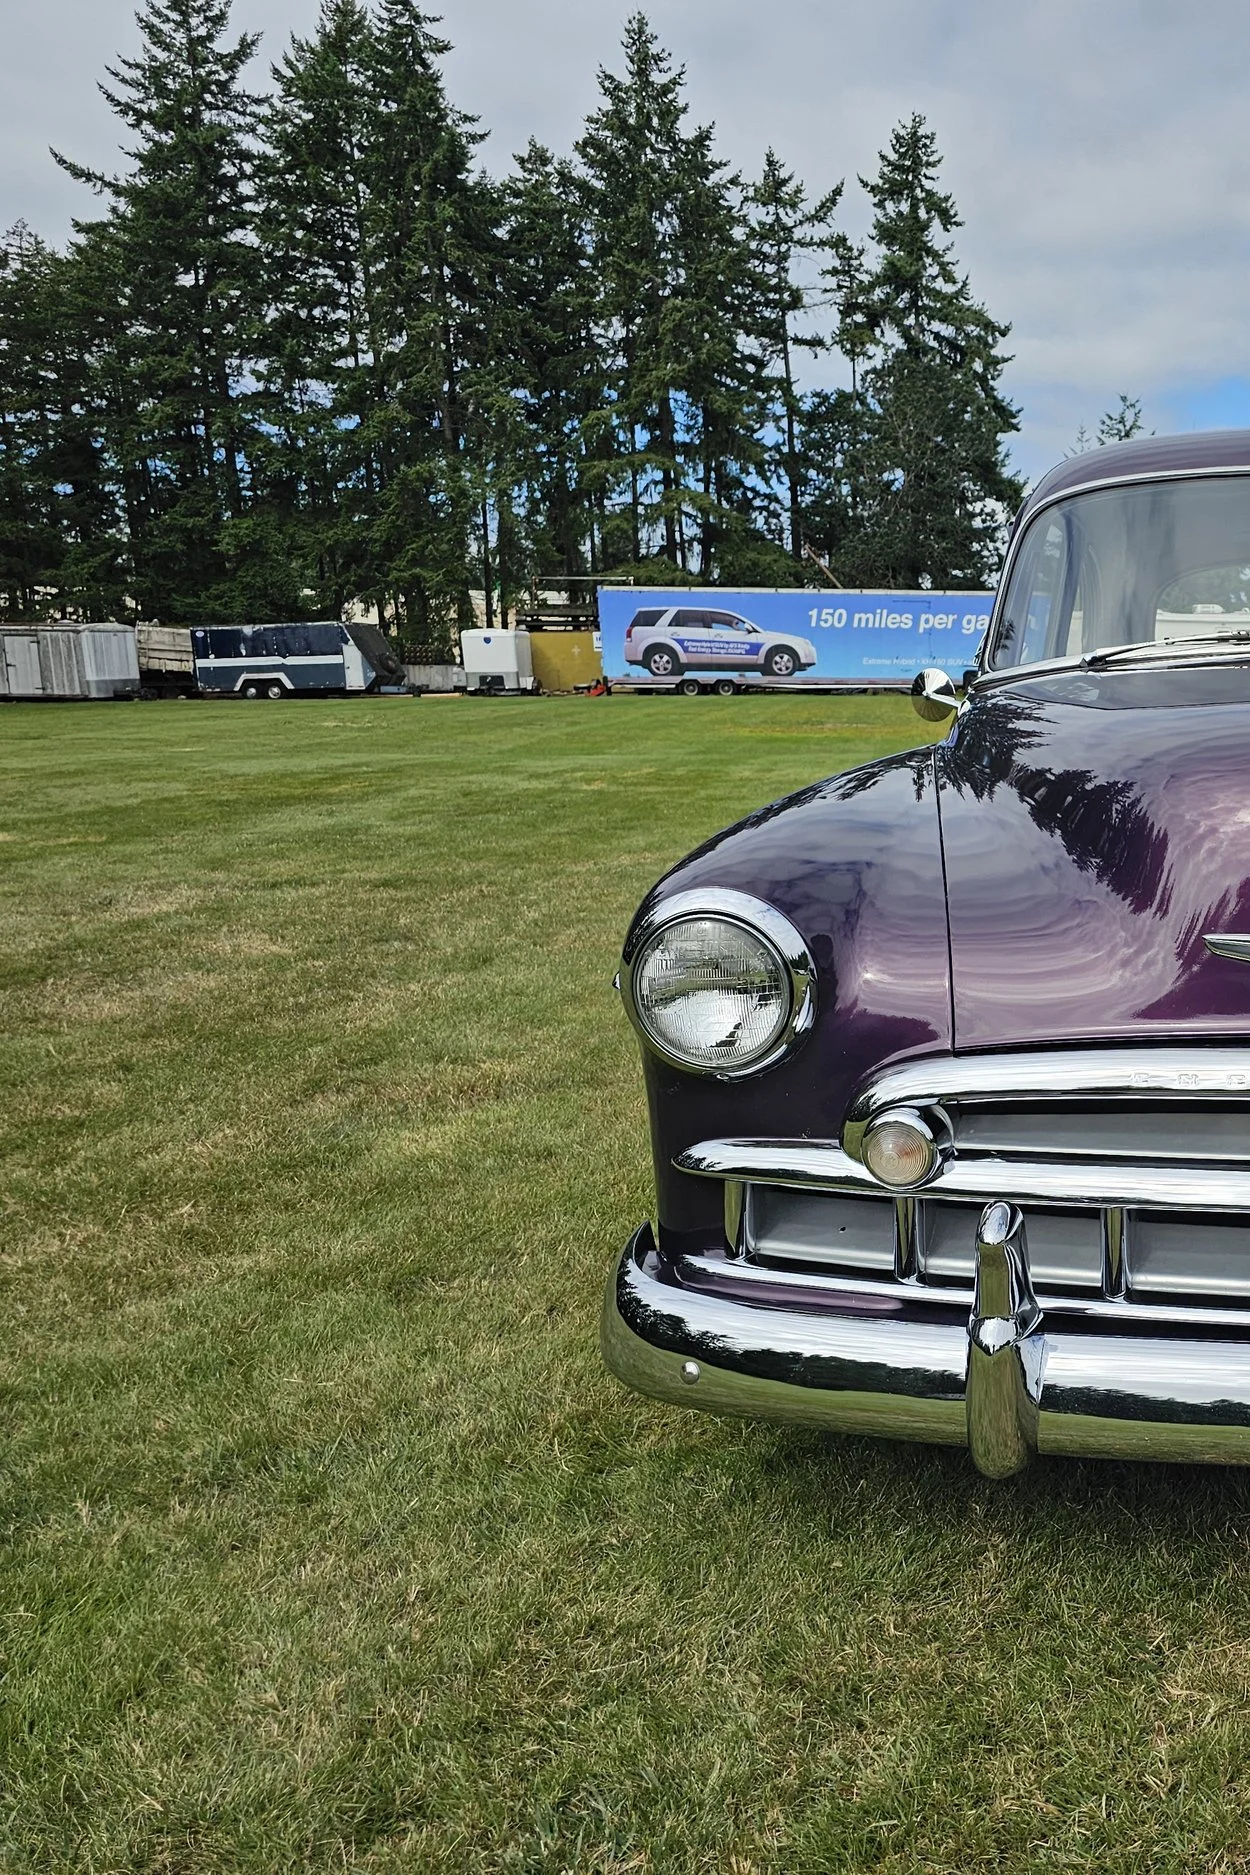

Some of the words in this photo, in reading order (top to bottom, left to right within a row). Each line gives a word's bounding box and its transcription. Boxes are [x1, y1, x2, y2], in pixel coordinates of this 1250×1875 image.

[808, 607, 848, 629] 150
[852, 608, 914, 629] miles
[918, 612, 958, 634] per
